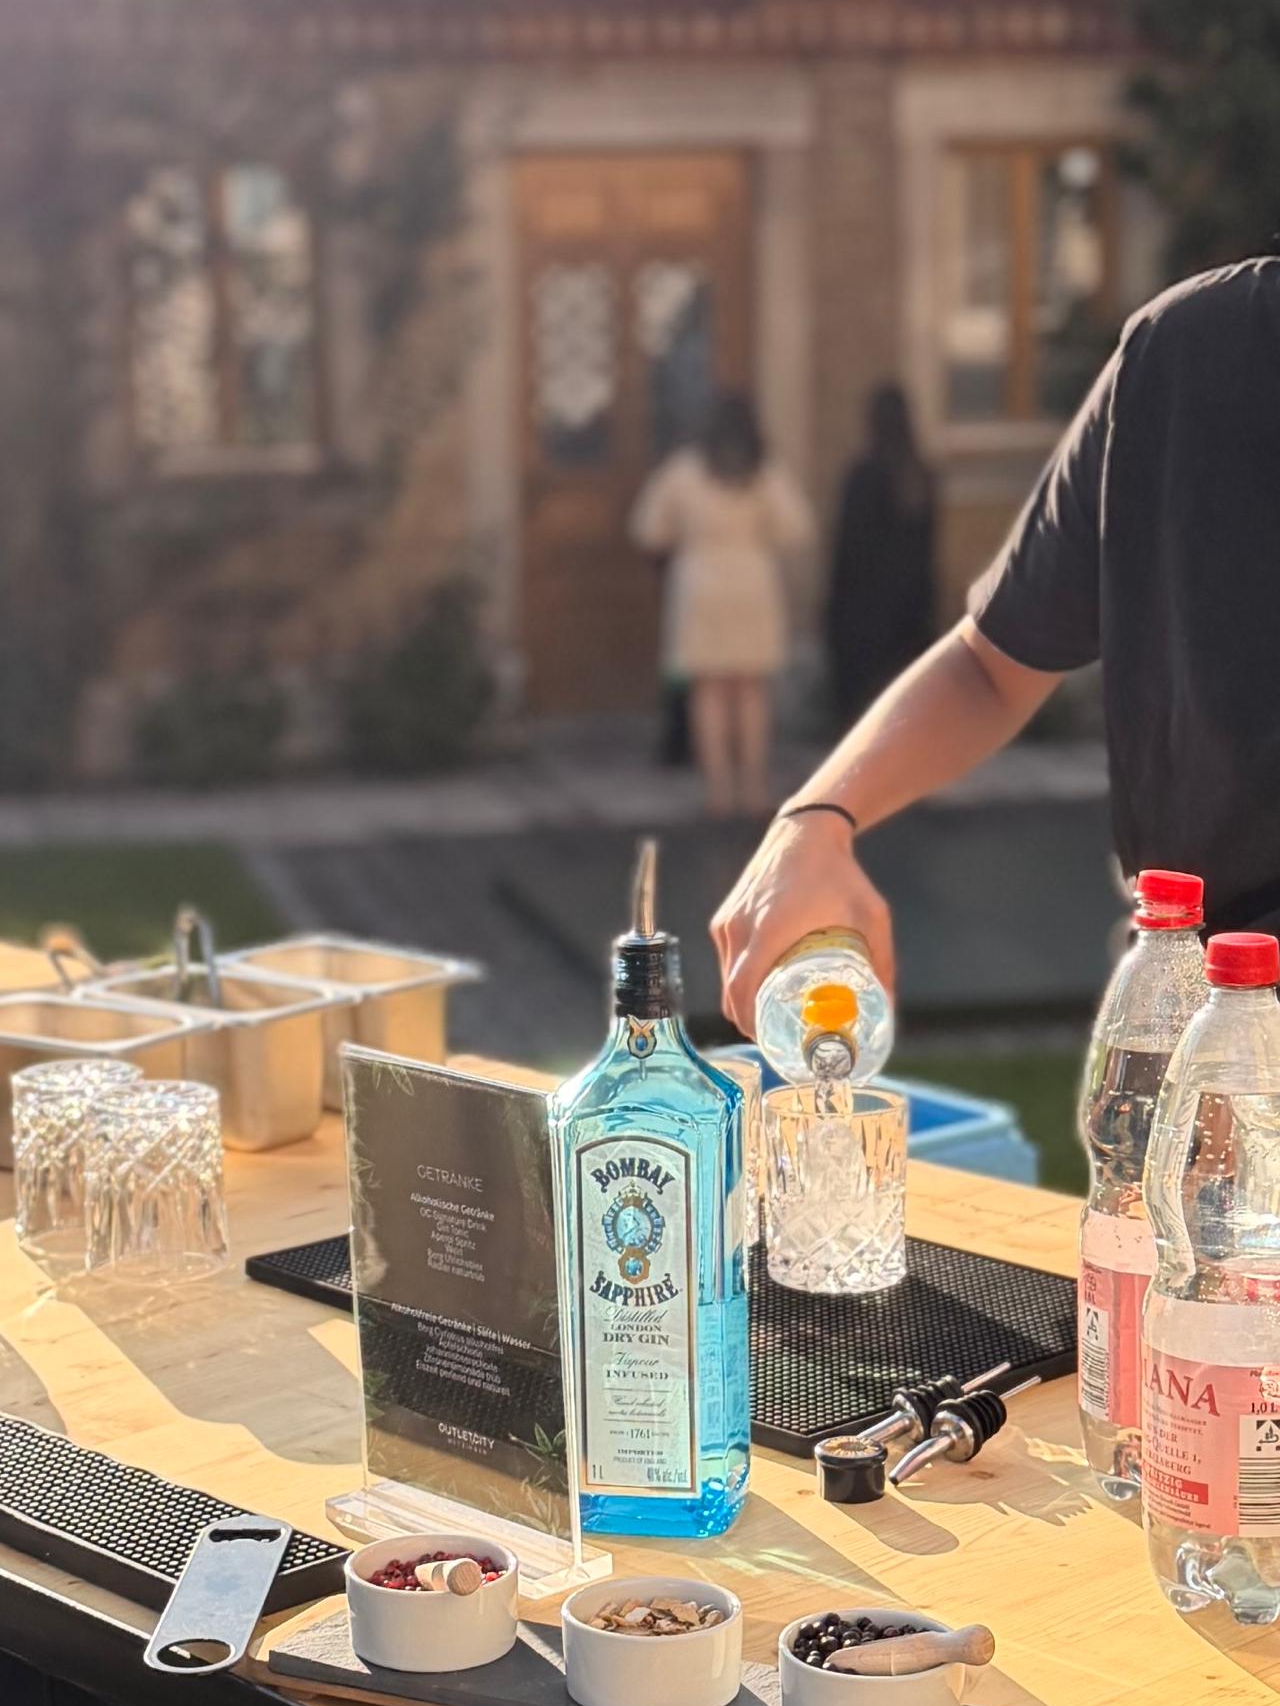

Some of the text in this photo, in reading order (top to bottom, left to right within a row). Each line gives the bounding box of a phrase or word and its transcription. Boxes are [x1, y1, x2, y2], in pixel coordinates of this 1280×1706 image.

[590, 1157, 675, 1195] BOMBAY
[589, 1270, 679, 1307] SAPPHIRE
[611, 1324, 662, 1332] LONDON
[603, 1332, 670, 1346] DRY GIN
[605, 1370, 669, 1380] INFUSED
